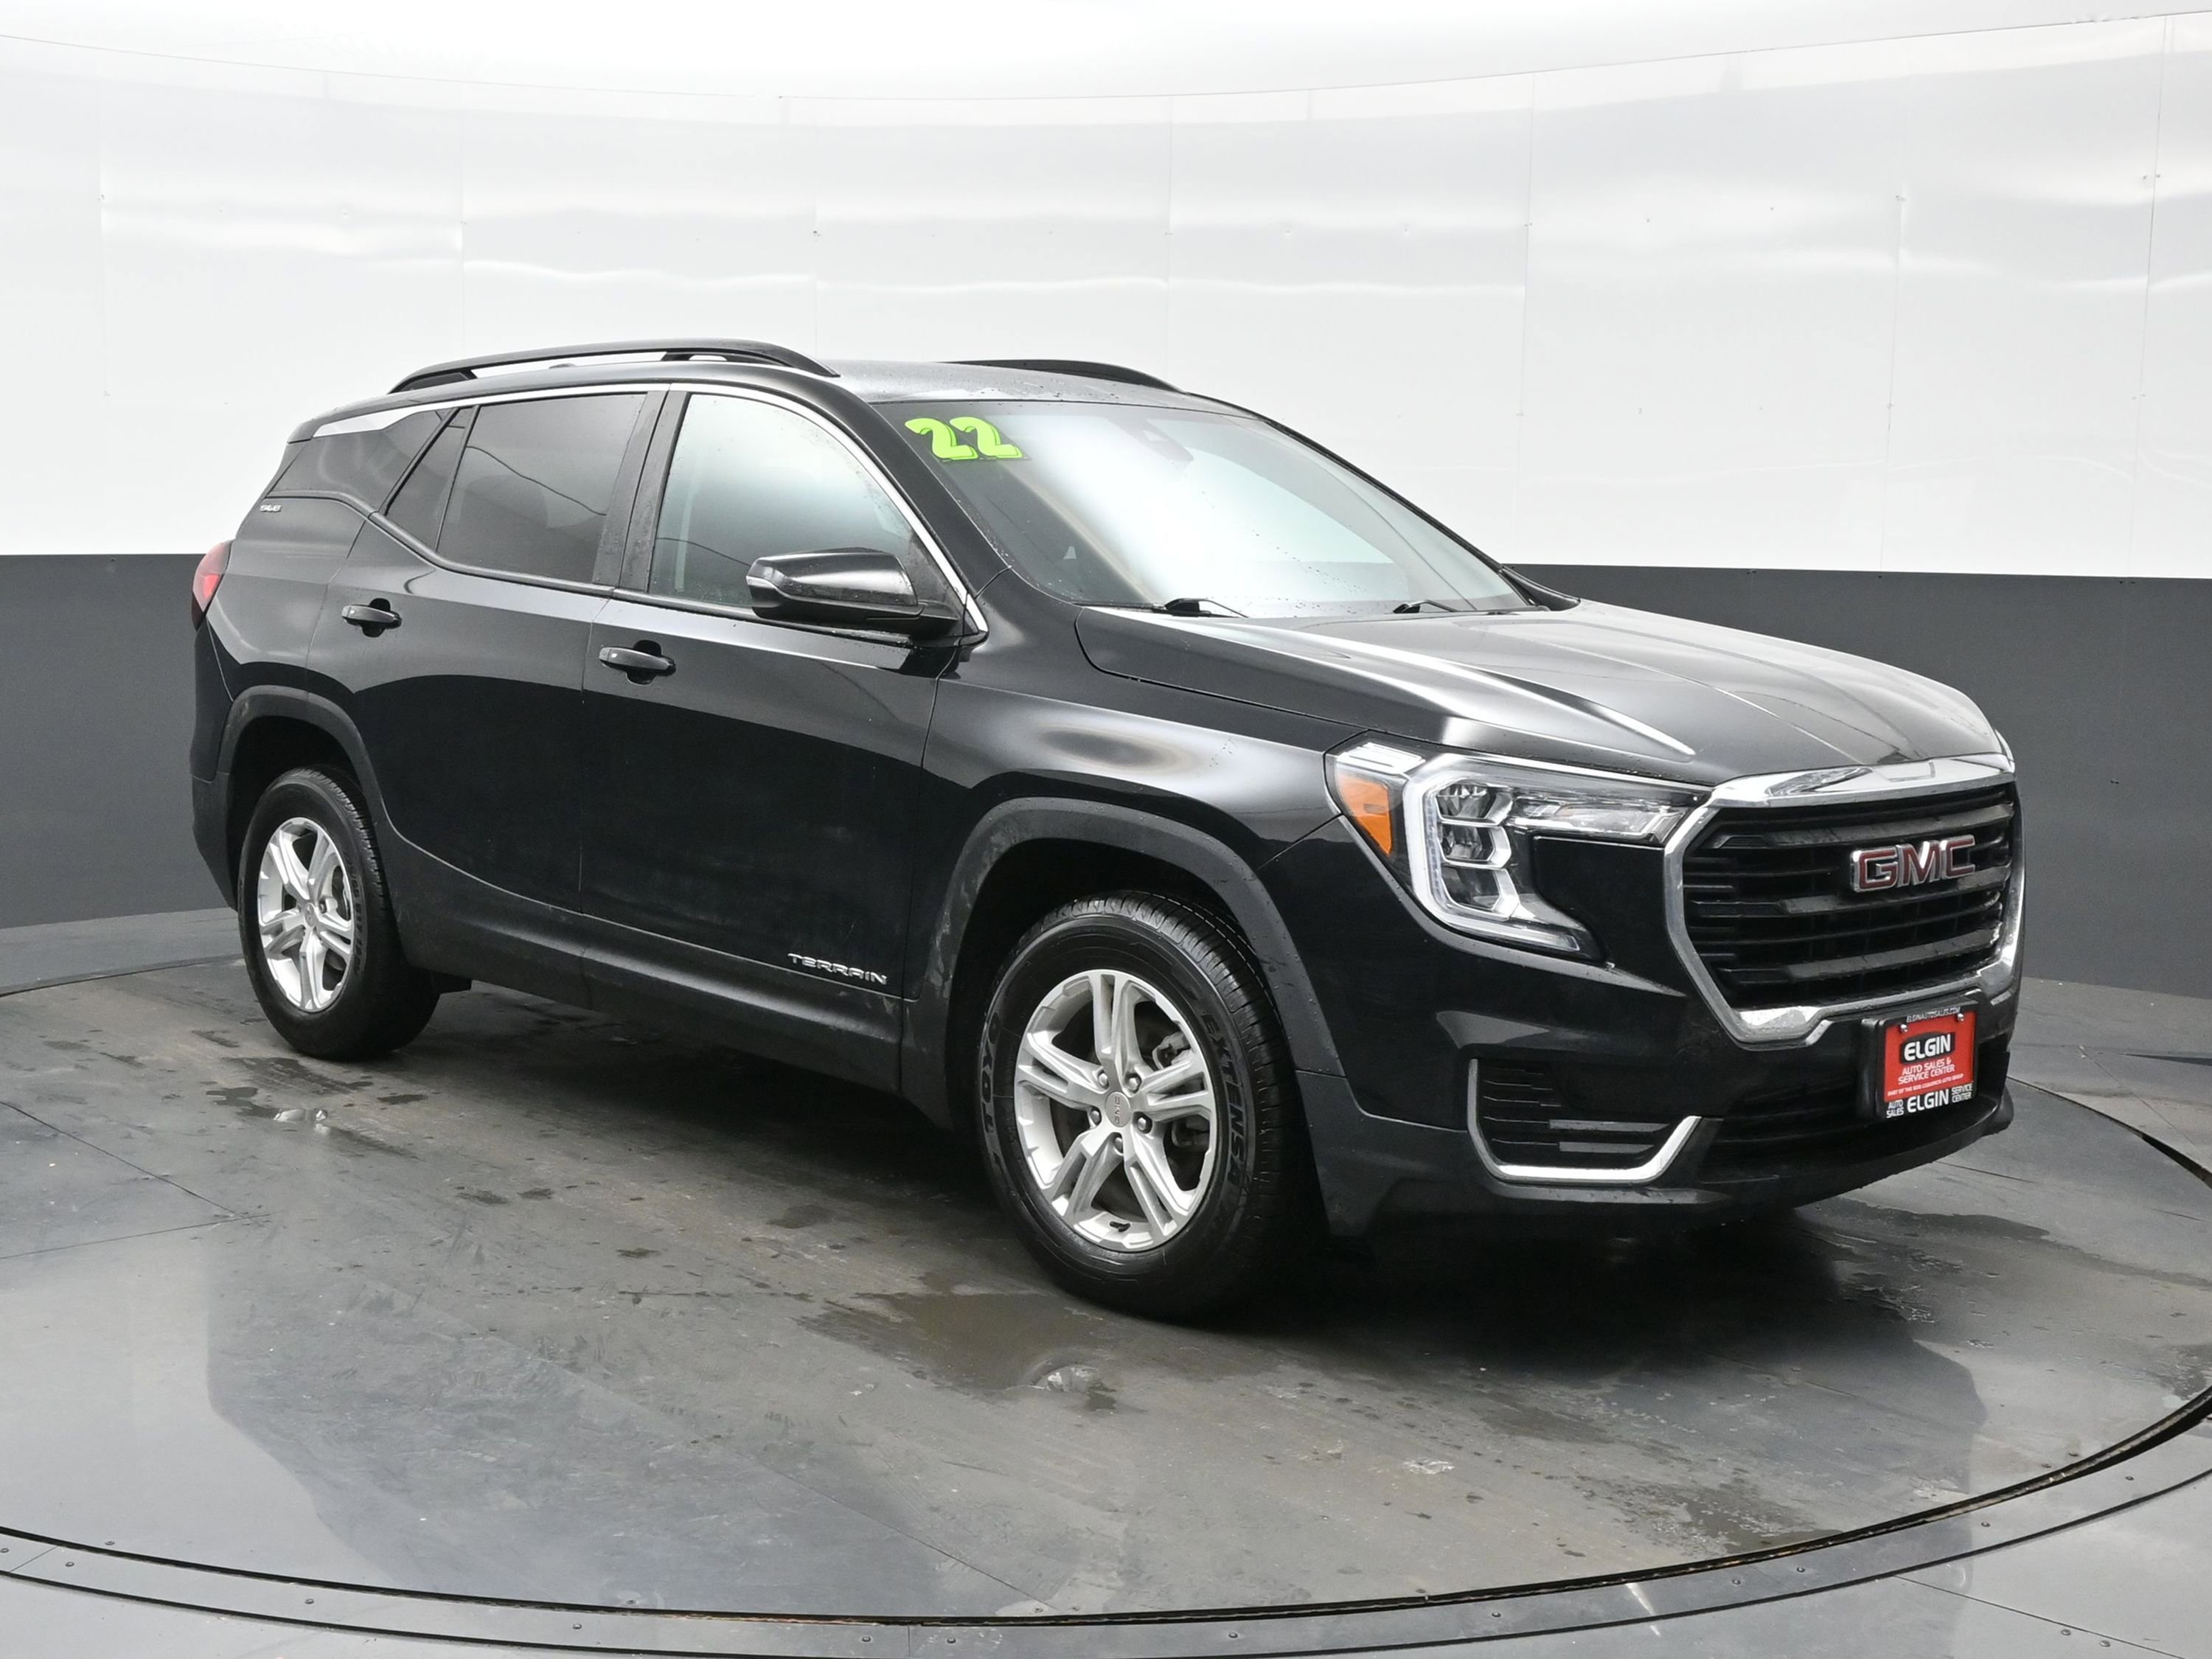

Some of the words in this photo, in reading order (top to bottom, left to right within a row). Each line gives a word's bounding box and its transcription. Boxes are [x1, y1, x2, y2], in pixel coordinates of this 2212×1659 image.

[905, 417, 1023, 460] 22
[1851, 835, 1975, 893] GMC
[787, 953, 887, 985] TERRAIN
[1904, 1034, 1951, 1062] ELGIN
[981, 1012, 1001, 1133] TOYO
[1898, 1070, 1929, 1085] SERVICE
[1930, 1064, 1955, 1077] CENTER
[1902, 1064, 1923, 1076] AUTO
[1924, 1059, 1945, 1071] SALES
[1947, 1057, 1952, 1065] &
[1201, 1013, 1245, 1186] EXTENSA
[1907, 1089, 1949, 1113] ELGIN
[1952, 1083, 1972, 1095] SERVICE
[1952, 1092, 1972, 1103] CENTER
[1886, 1107, 1905, 1119] SALES
[1888, 1099, 1903, 1110] AUTO
